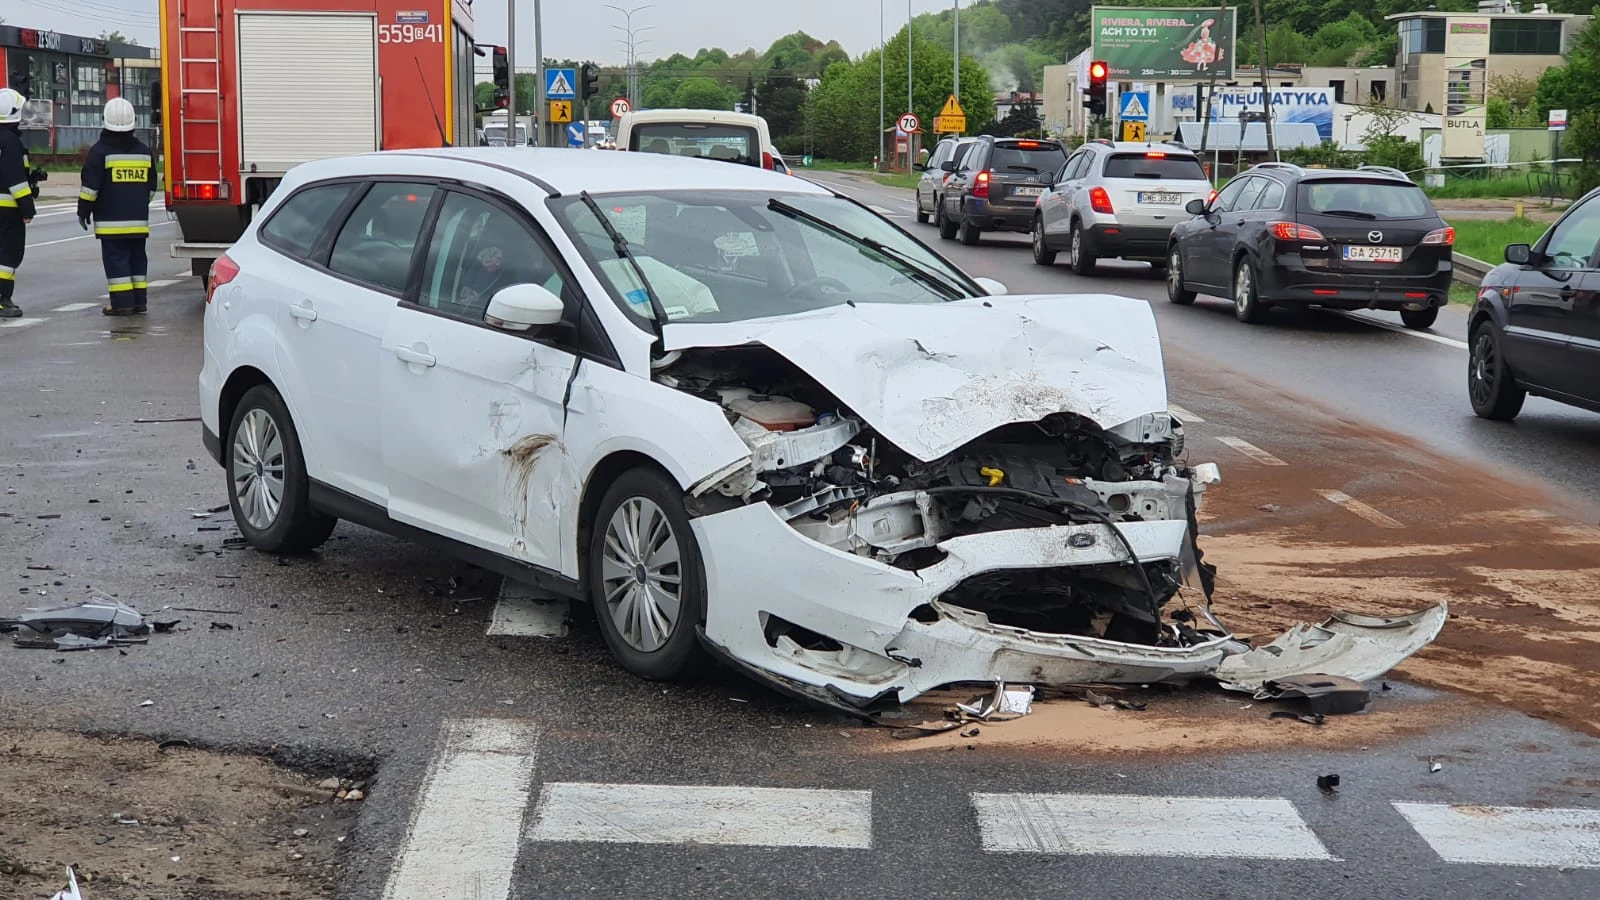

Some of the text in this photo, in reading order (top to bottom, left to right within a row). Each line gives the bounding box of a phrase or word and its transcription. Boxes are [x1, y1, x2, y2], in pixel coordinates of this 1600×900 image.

[1101, 18, 1143, 27] RIVIERA,
[1101, 28, 1157, 36] ACH TO TY!
[614, 103, 628, 113] 70
[903, 118, 916, 128] 70
[1350, 247, 1400, 258] GA 2571R
